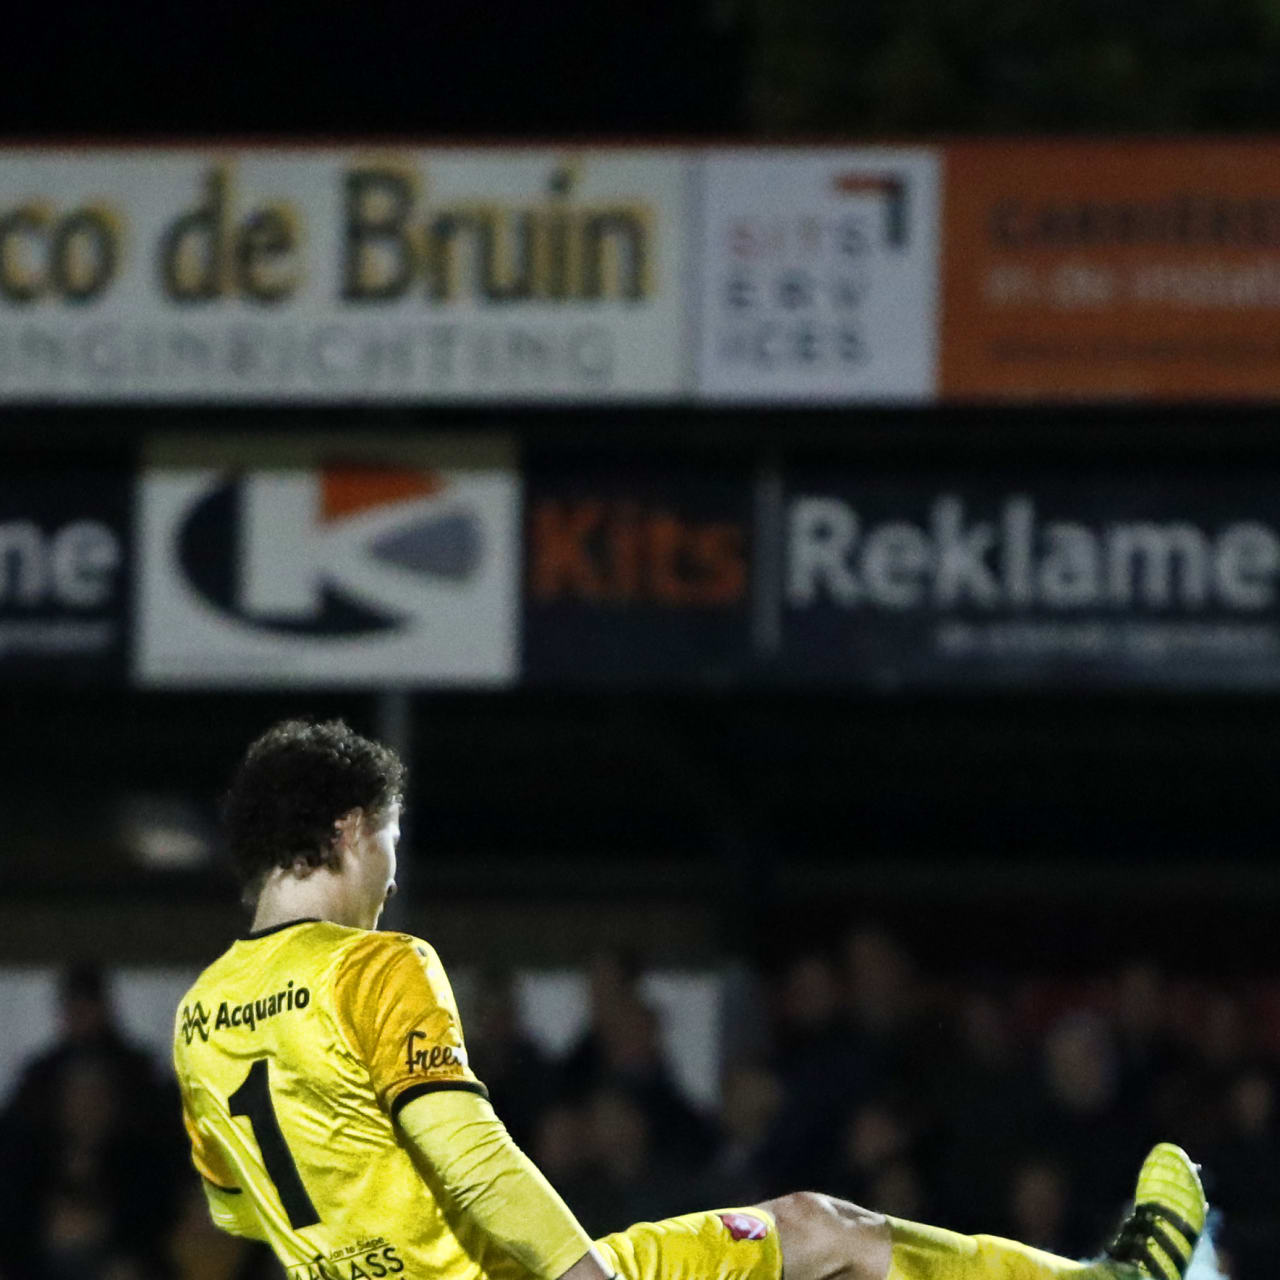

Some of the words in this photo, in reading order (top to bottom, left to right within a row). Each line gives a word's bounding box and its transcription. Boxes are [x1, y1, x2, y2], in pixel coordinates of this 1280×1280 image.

[157, 160, 301, 308] de
[337, 150, 655, 308] Bruin
[529, 497, 748, 603] Kits
[214, 980, 311, 1032] Acquario
[227, 1058, 320, 1230] 1
